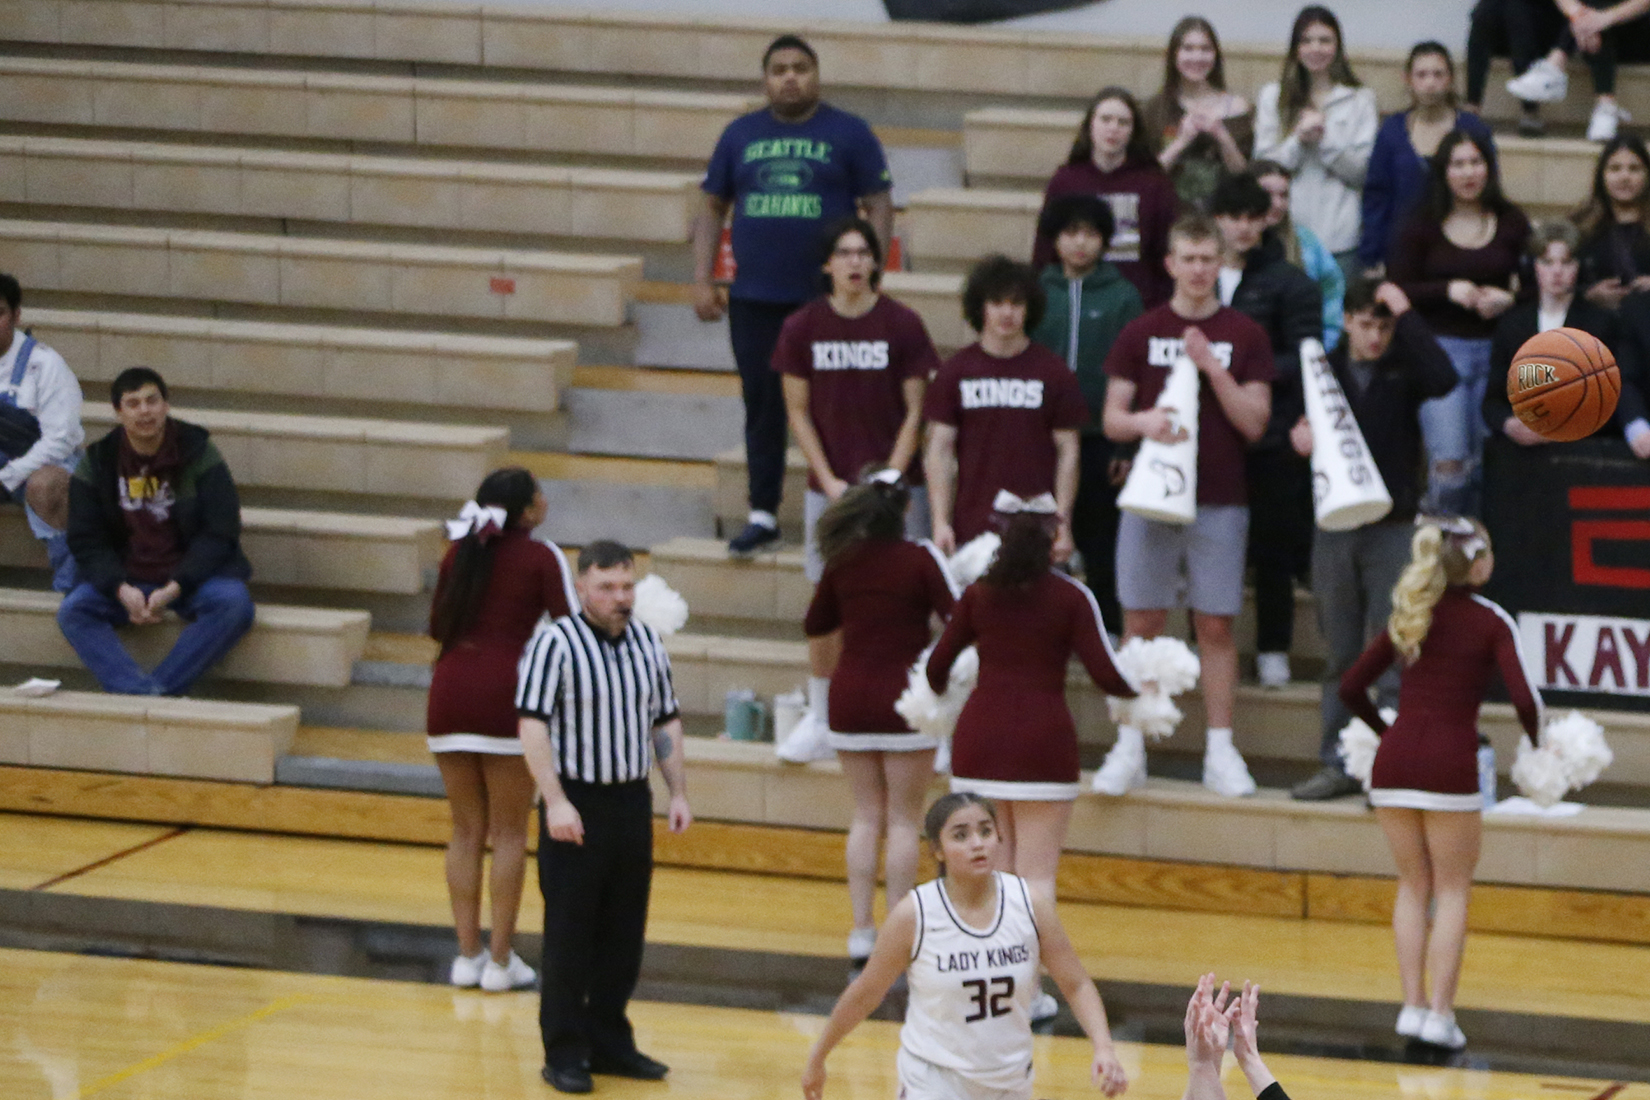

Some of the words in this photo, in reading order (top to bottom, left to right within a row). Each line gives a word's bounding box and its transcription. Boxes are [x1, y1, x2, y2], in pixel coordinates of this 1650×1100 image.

[742, 137, 833, 165] SEATTLE
[744, 191, 823, 220] SEAHAWKS
[811, 339, 890, 371] KINGS
[1516, 362, 1557, 393] ROCK
[958, 377, 1045, 410] KINGS
[936, 949, 980, 973] LADY
[986, 944, 1030, 969] KINGS
[962, 975, 1016, 1024] 32
